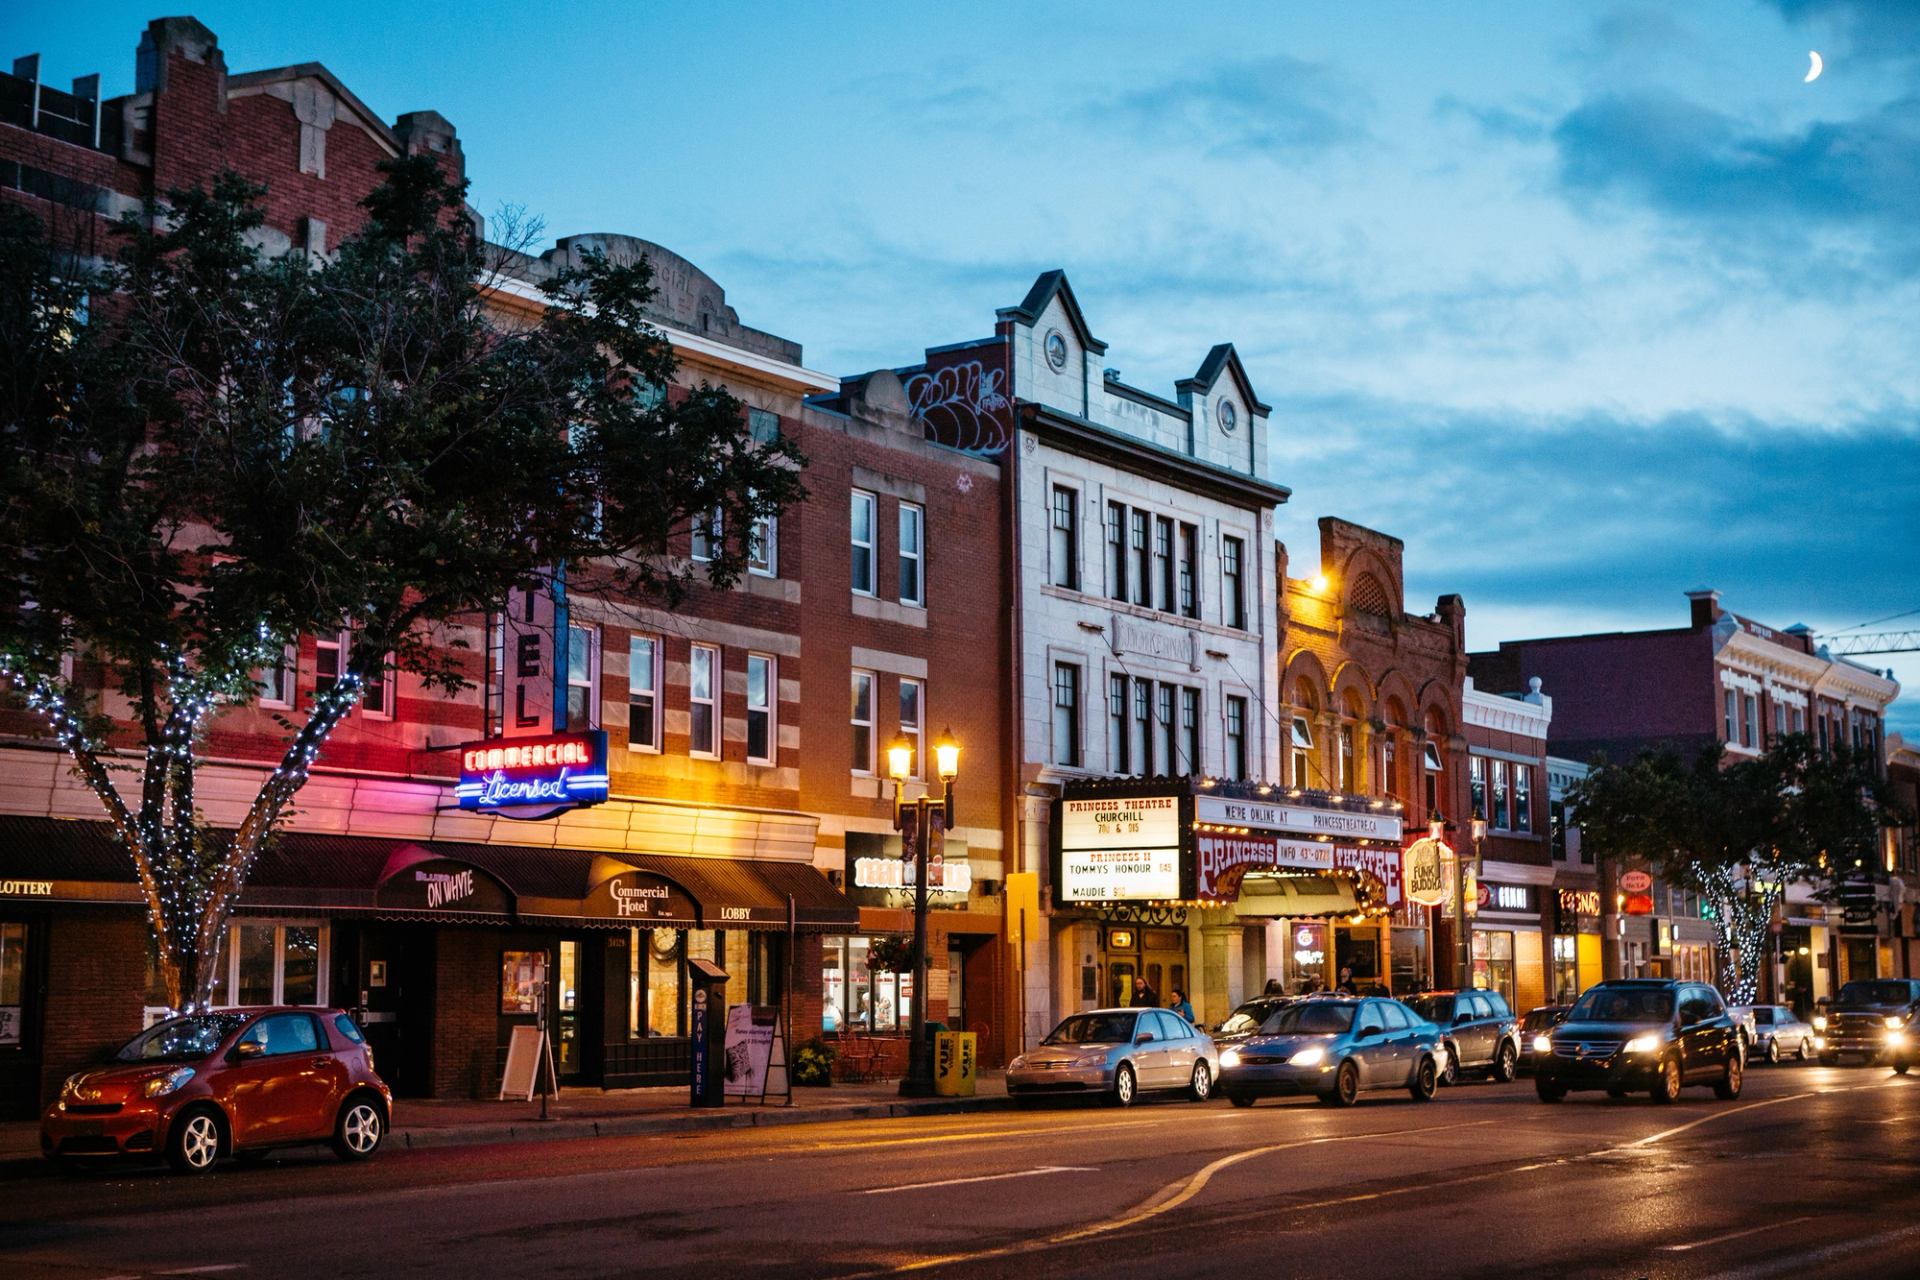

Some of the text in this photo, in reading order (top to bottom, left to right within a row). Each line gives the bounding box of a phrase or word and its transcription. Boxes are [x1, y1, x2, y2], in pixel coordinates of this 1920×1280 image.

[464, 741, 589, 772] COMMERCIAL
[479, 766, 568, 804] Licensed
[1069, 799, 1172, 812] PRINCESS THEATRE
[1094, 812, 1144, 823] CHURCHILL
[1250, 807, 1275, 823] ONLINE
[1280, 811, 1288, 823] AT
[1313, 814, 1377, 832] PRINCESSTHEATRE.CA
[1090, 852, 1140, 863] PRINCESS
[1199, 837, 1274, 896] PRINCESS
[1069, 865, 1109, 875] TOMMYS
[1115, 863, 1151, 873] HONOUR
[1335, 847, 1401, 905] THEATRE
[0, 880, 54, 895] LOTTERY
[427, 869, 474, 908] ON WHYTE
[609, 879, 669, 900] Commercial
[1072, 887, 1106, 897] MAUDIE
[617, 898, 648, 916] Hotel
[721, 907, 751, 919] LOBBY
[940, 1039, 949, 1079] VUE
